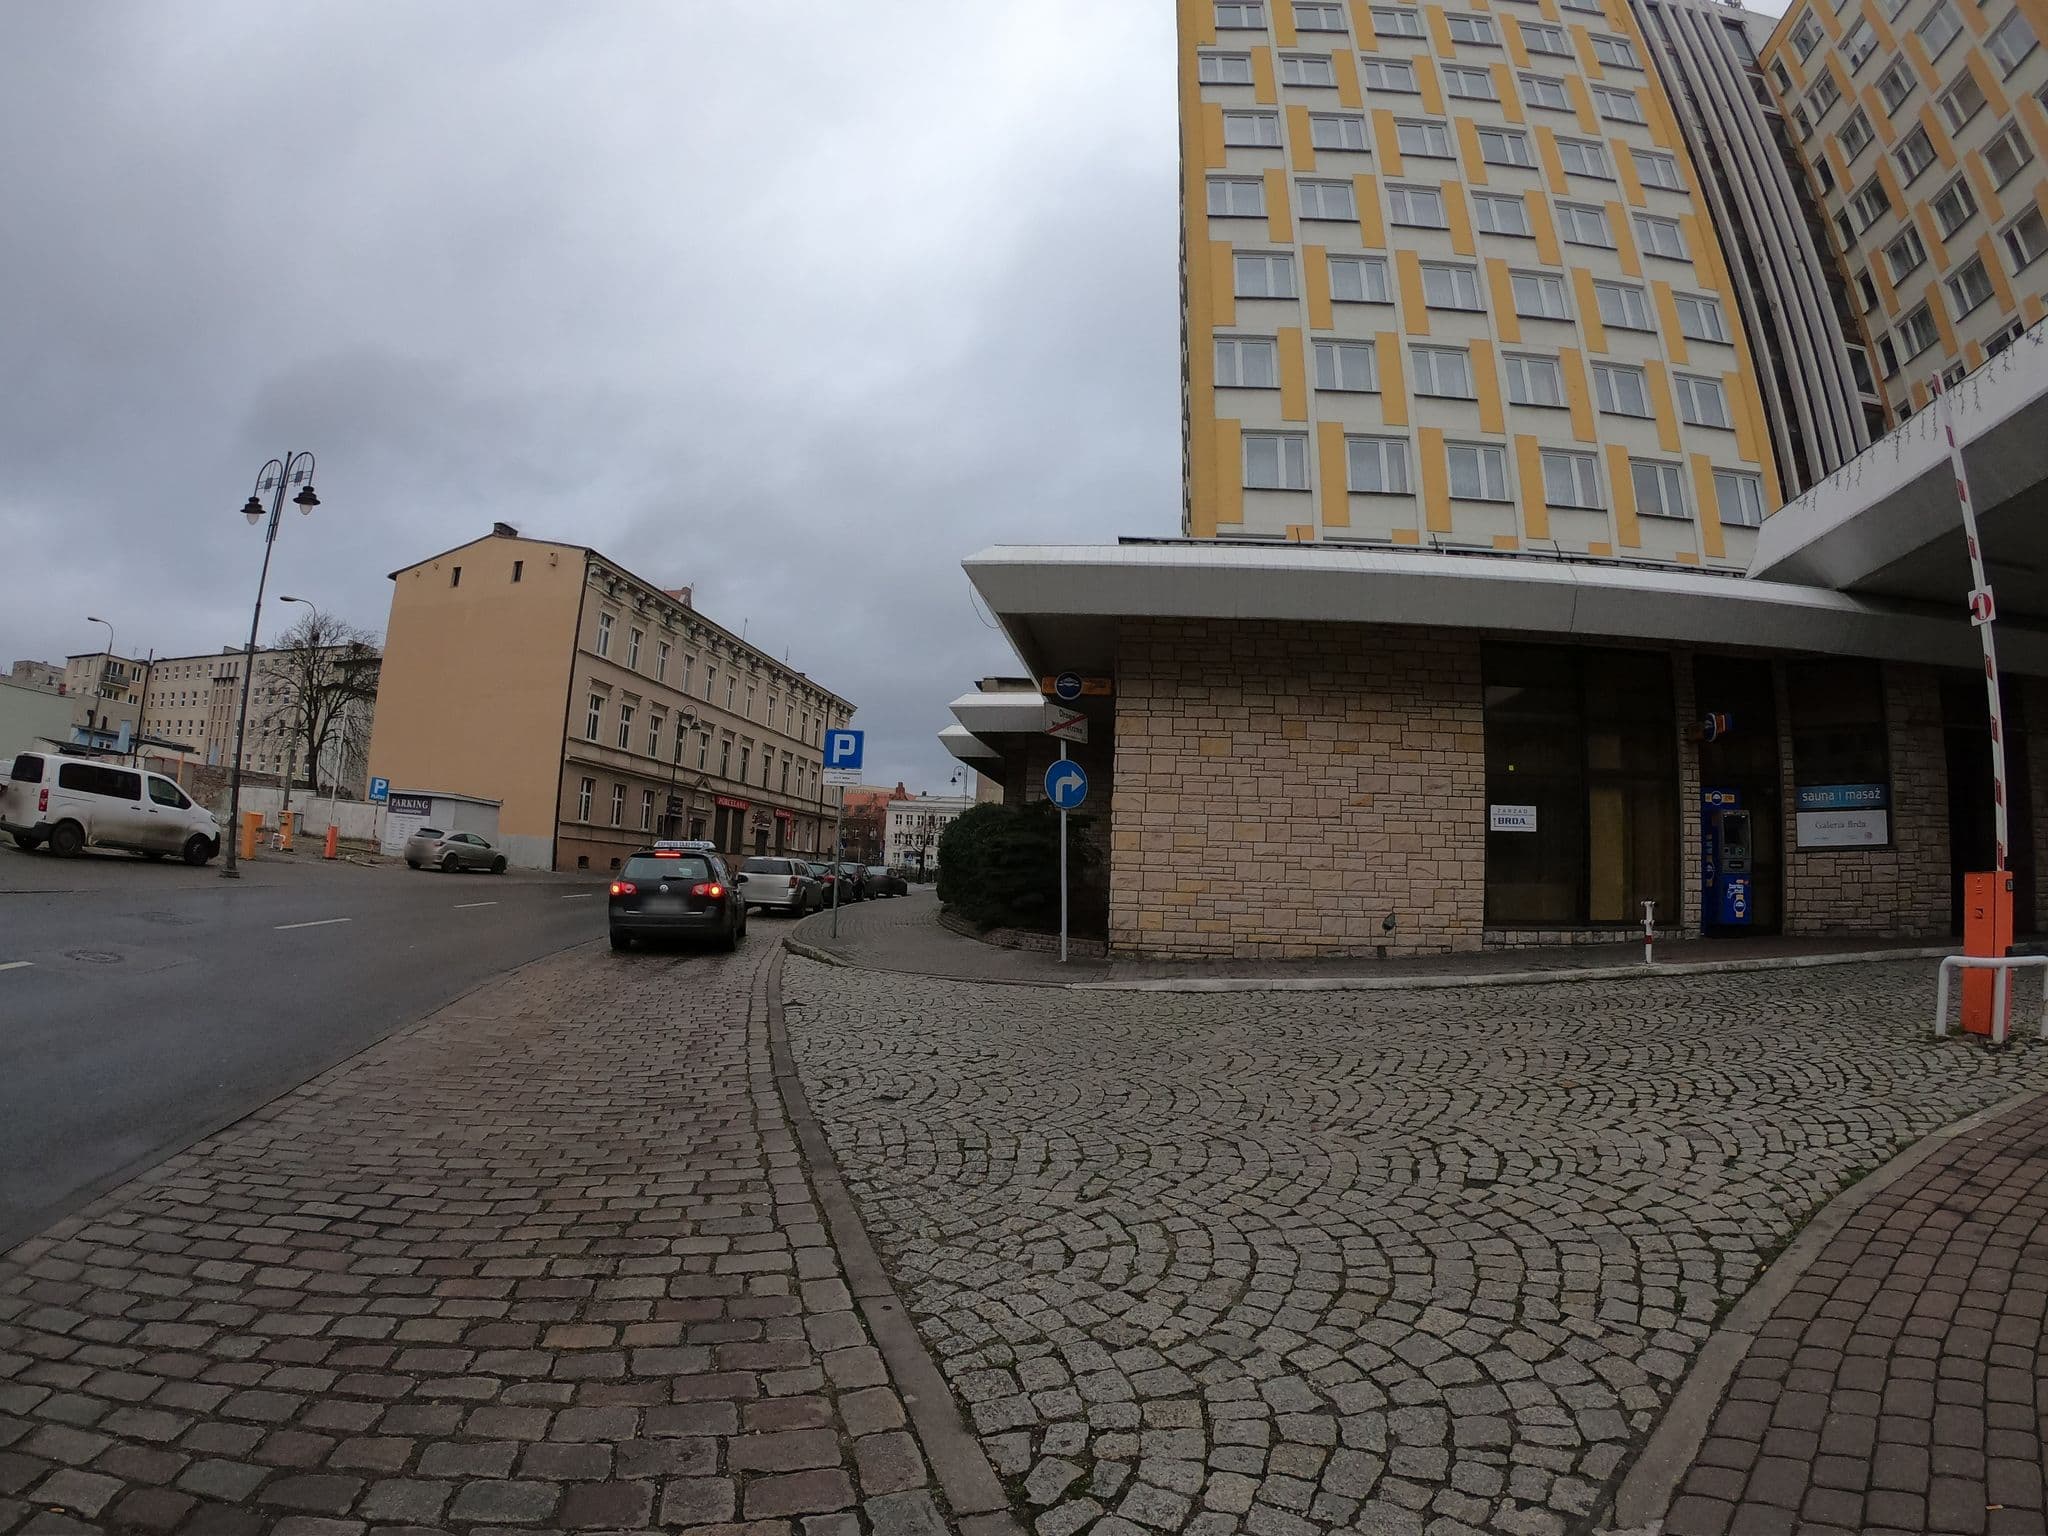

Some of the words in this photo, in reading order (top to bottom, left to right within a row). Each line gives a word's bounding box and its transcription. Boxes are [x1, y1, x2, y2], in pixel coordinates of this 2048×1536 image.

[832, 734, 856, 763] P
[374, 778, 387, 794] P
[1802, 791, 1835, 802] sauna
[1845, 787, 1881, 801] masaż
[391, 798, 429, 809] PARKING
[1498, 817, 1526, 825] BRDA
